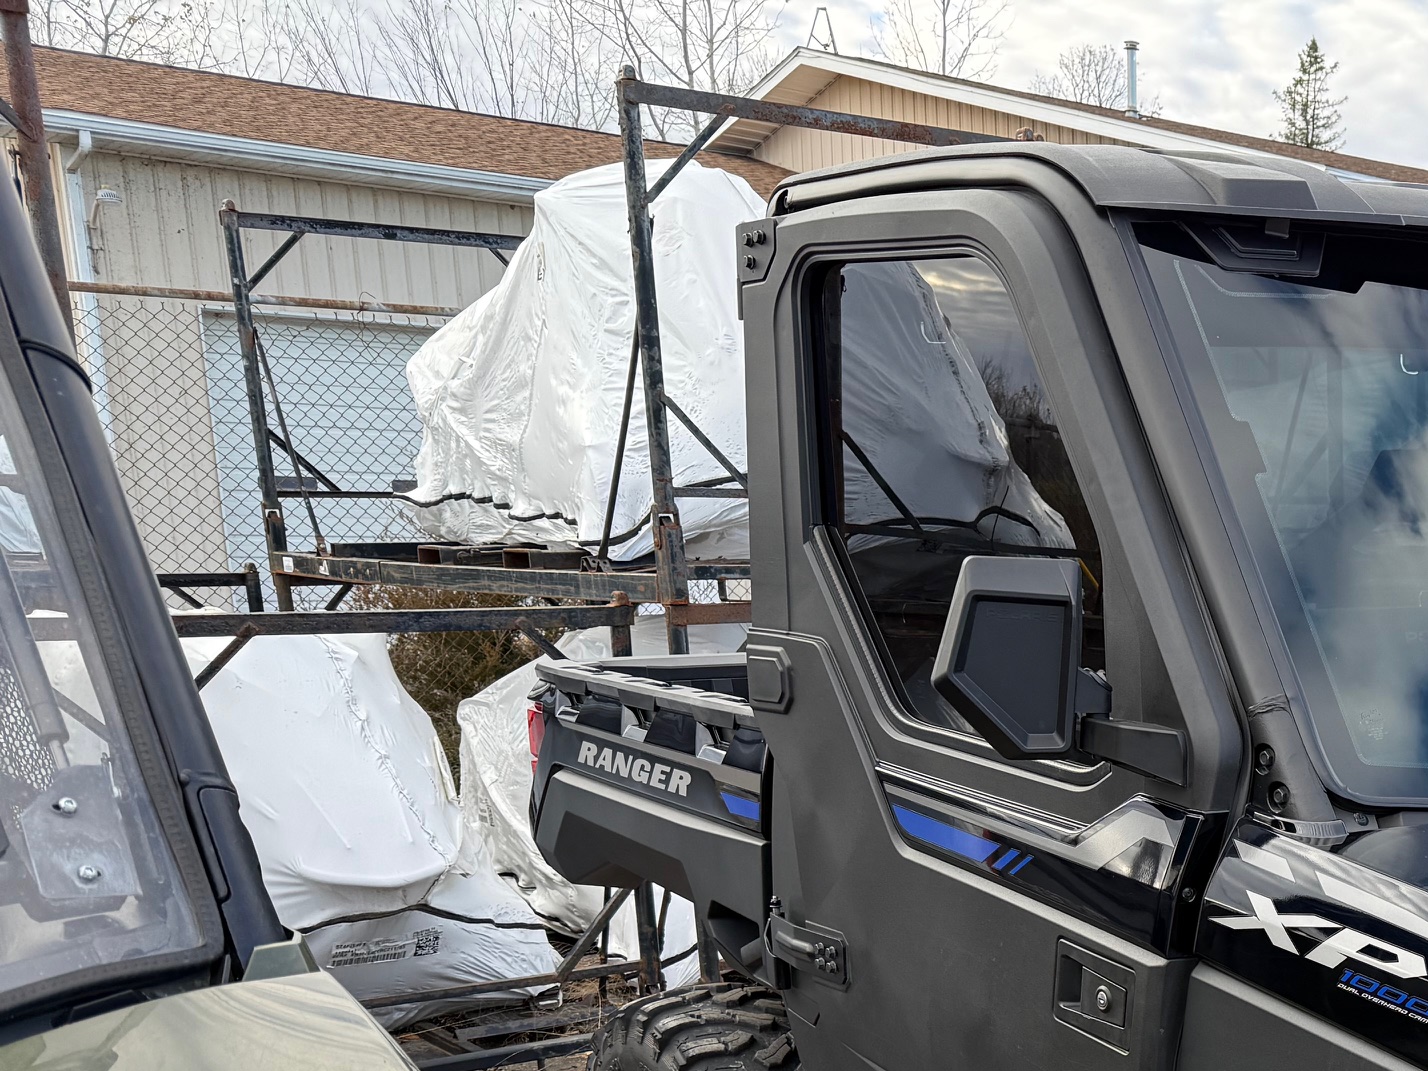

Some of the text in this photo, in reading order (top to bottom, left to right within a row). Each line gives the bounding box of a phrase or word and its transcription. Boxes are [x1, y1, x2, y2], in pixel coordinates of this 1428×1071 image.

[577, 740, 692, 797] RANGER
[1208, 889, 1428, 979] XP
[1337, 983, 1360, 997] DUAL
